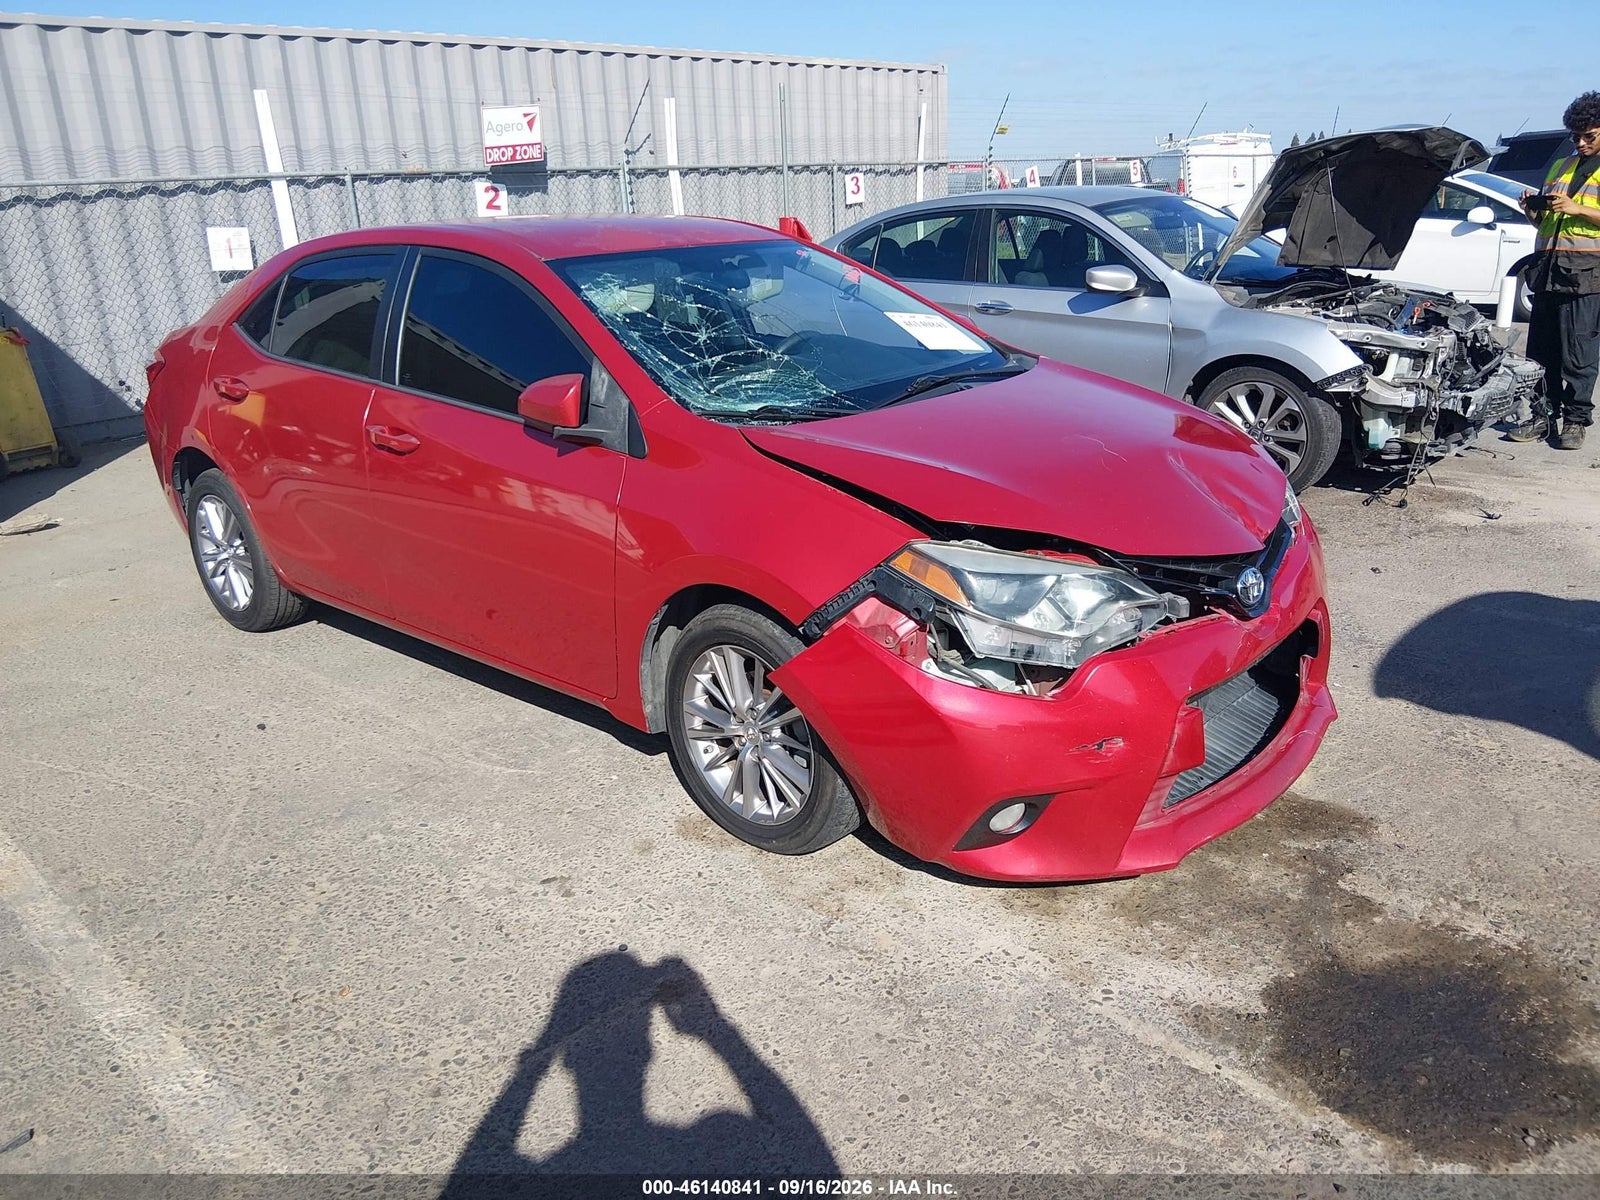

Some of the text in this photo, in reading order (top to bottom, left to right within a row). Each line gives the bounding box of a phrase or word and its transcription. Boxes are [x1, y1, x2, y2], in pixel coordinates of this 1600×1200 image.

[486, 120, 523, 136] Agero
[486, 144, 542, 163] DROP ZONE
[1029, 169, 1037, 185] 4
[1132, 162, 1138, 176] 5
[1232, 166, 1238, 178] 6
[850, 176, 861, 195] 3
[484, 185, 502, 211] 2
[225, 237, 233, 259] 1
